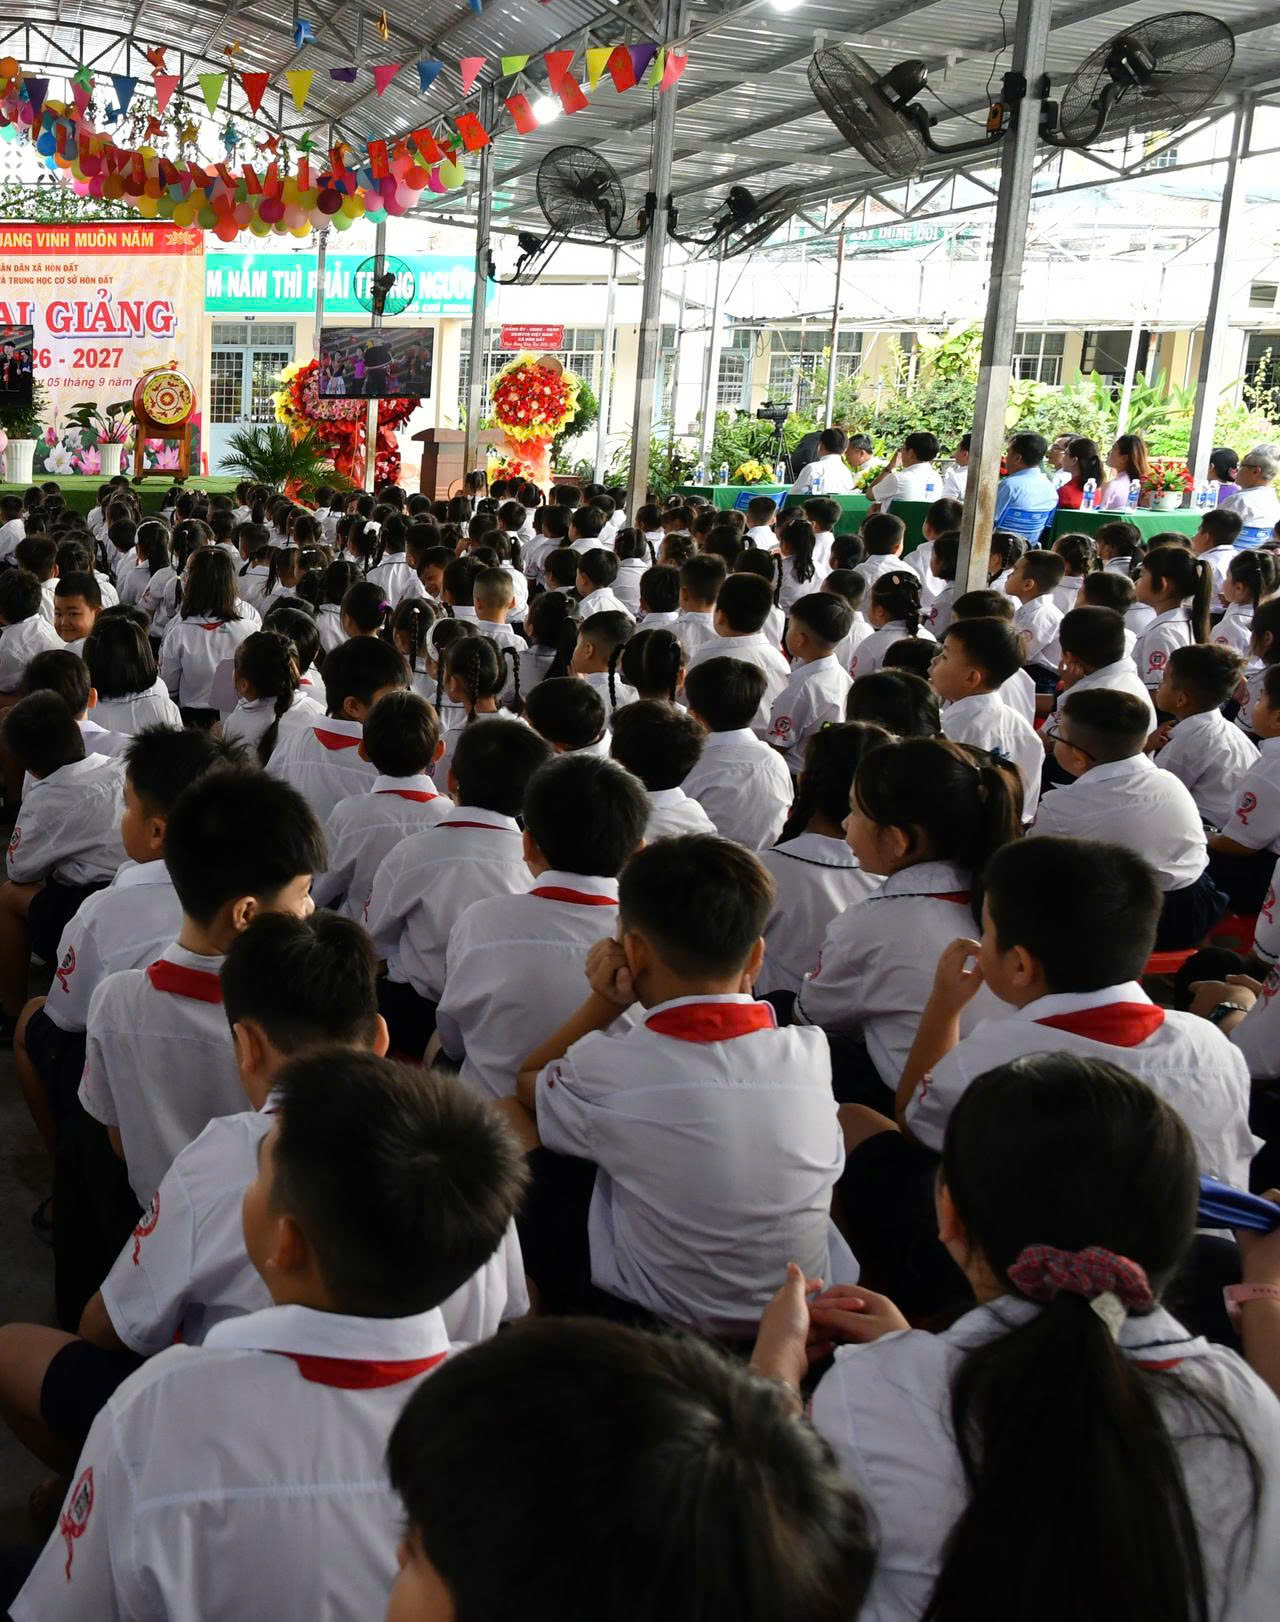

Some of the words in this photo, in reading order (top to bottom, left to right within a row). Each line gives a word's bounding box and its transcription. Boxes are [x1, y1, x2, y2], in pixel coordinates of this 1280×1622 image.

[35, 232, 70, 247] VINH
[74, 229, 118, 248] MUÔN
[121, 229, 154, 248] NĂM
[14, 262, 30, 272] DÂN
[32, 262, 42, 272] XÃ
[9, 276, 35, 285] TRUNG
[36, 276, 53, 286] HỌC
[54, 275, 66, 285] CƠ
[67, 274, 78, 285] SỞ
[272, 263, 302, 298] THÌ
[356, 260, 414, 299] TRNG
[45, 288, 175, 335] GIẢNG
[72, 347, 124, 369] 2027
[47, 377, 60, 387] 05
[63, 377, 96, 389] tháng
[98, 377, 105, 387] 9
[108, 377, 133, 387] năm
